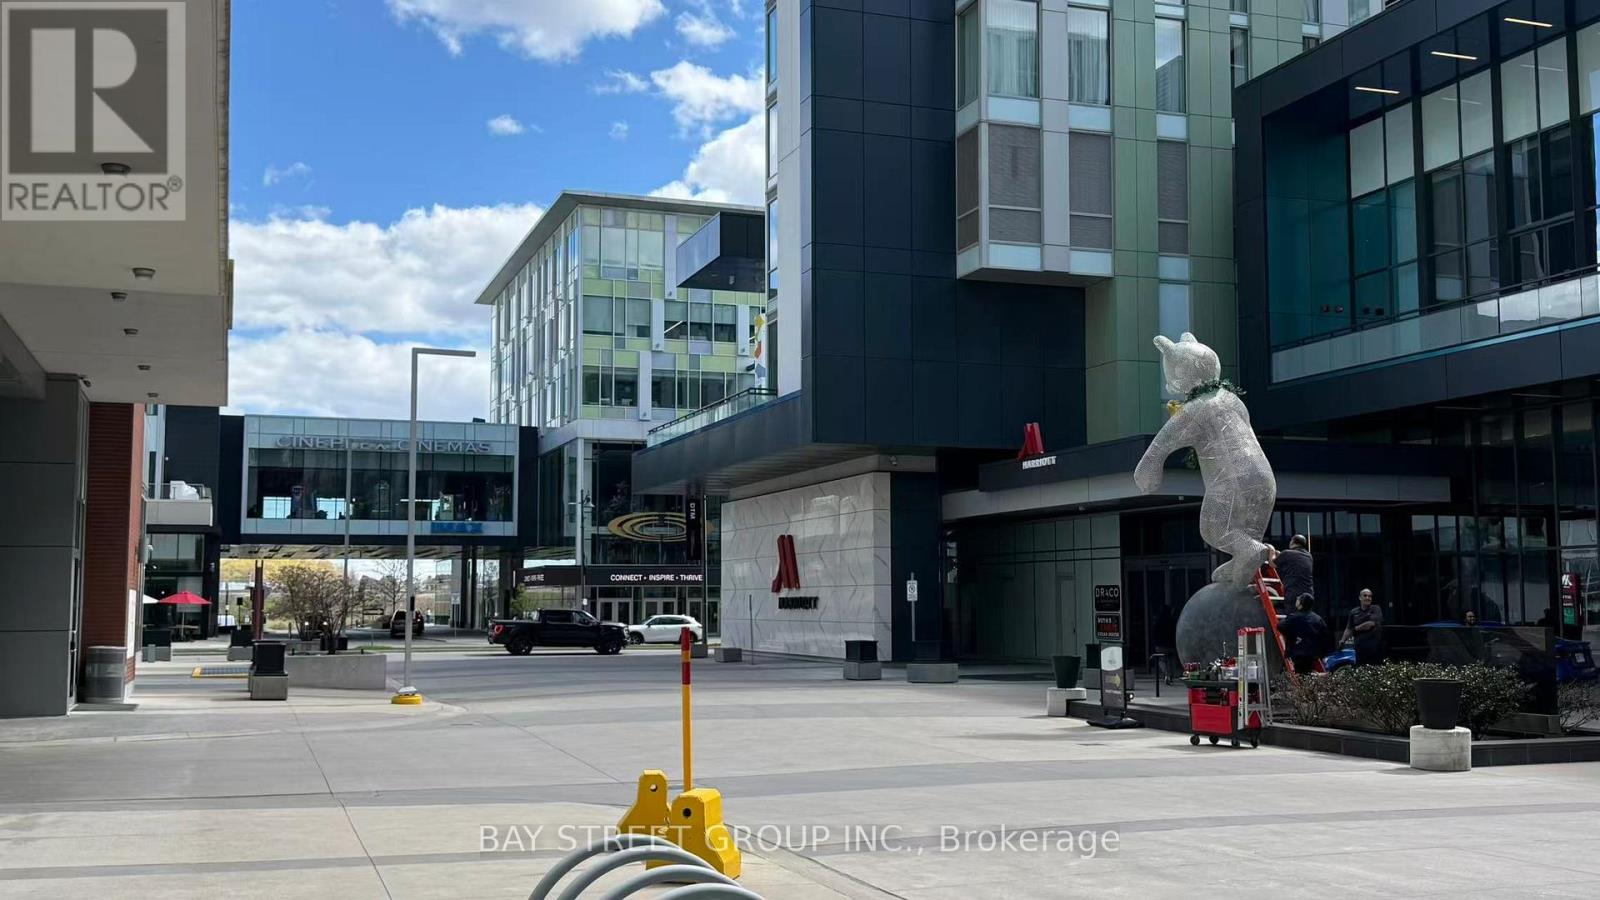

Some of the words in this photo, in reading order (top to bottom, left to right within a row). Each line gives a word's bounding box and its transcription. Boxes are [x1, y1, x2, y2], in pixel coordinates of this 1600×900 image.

[398, 439, 491, 453] CNEMAS
[610, 574, 643, 582] CONNECT
[648, 574, 675, 582] INSPIRE
[679, 574, 703, 582] THRIVE
